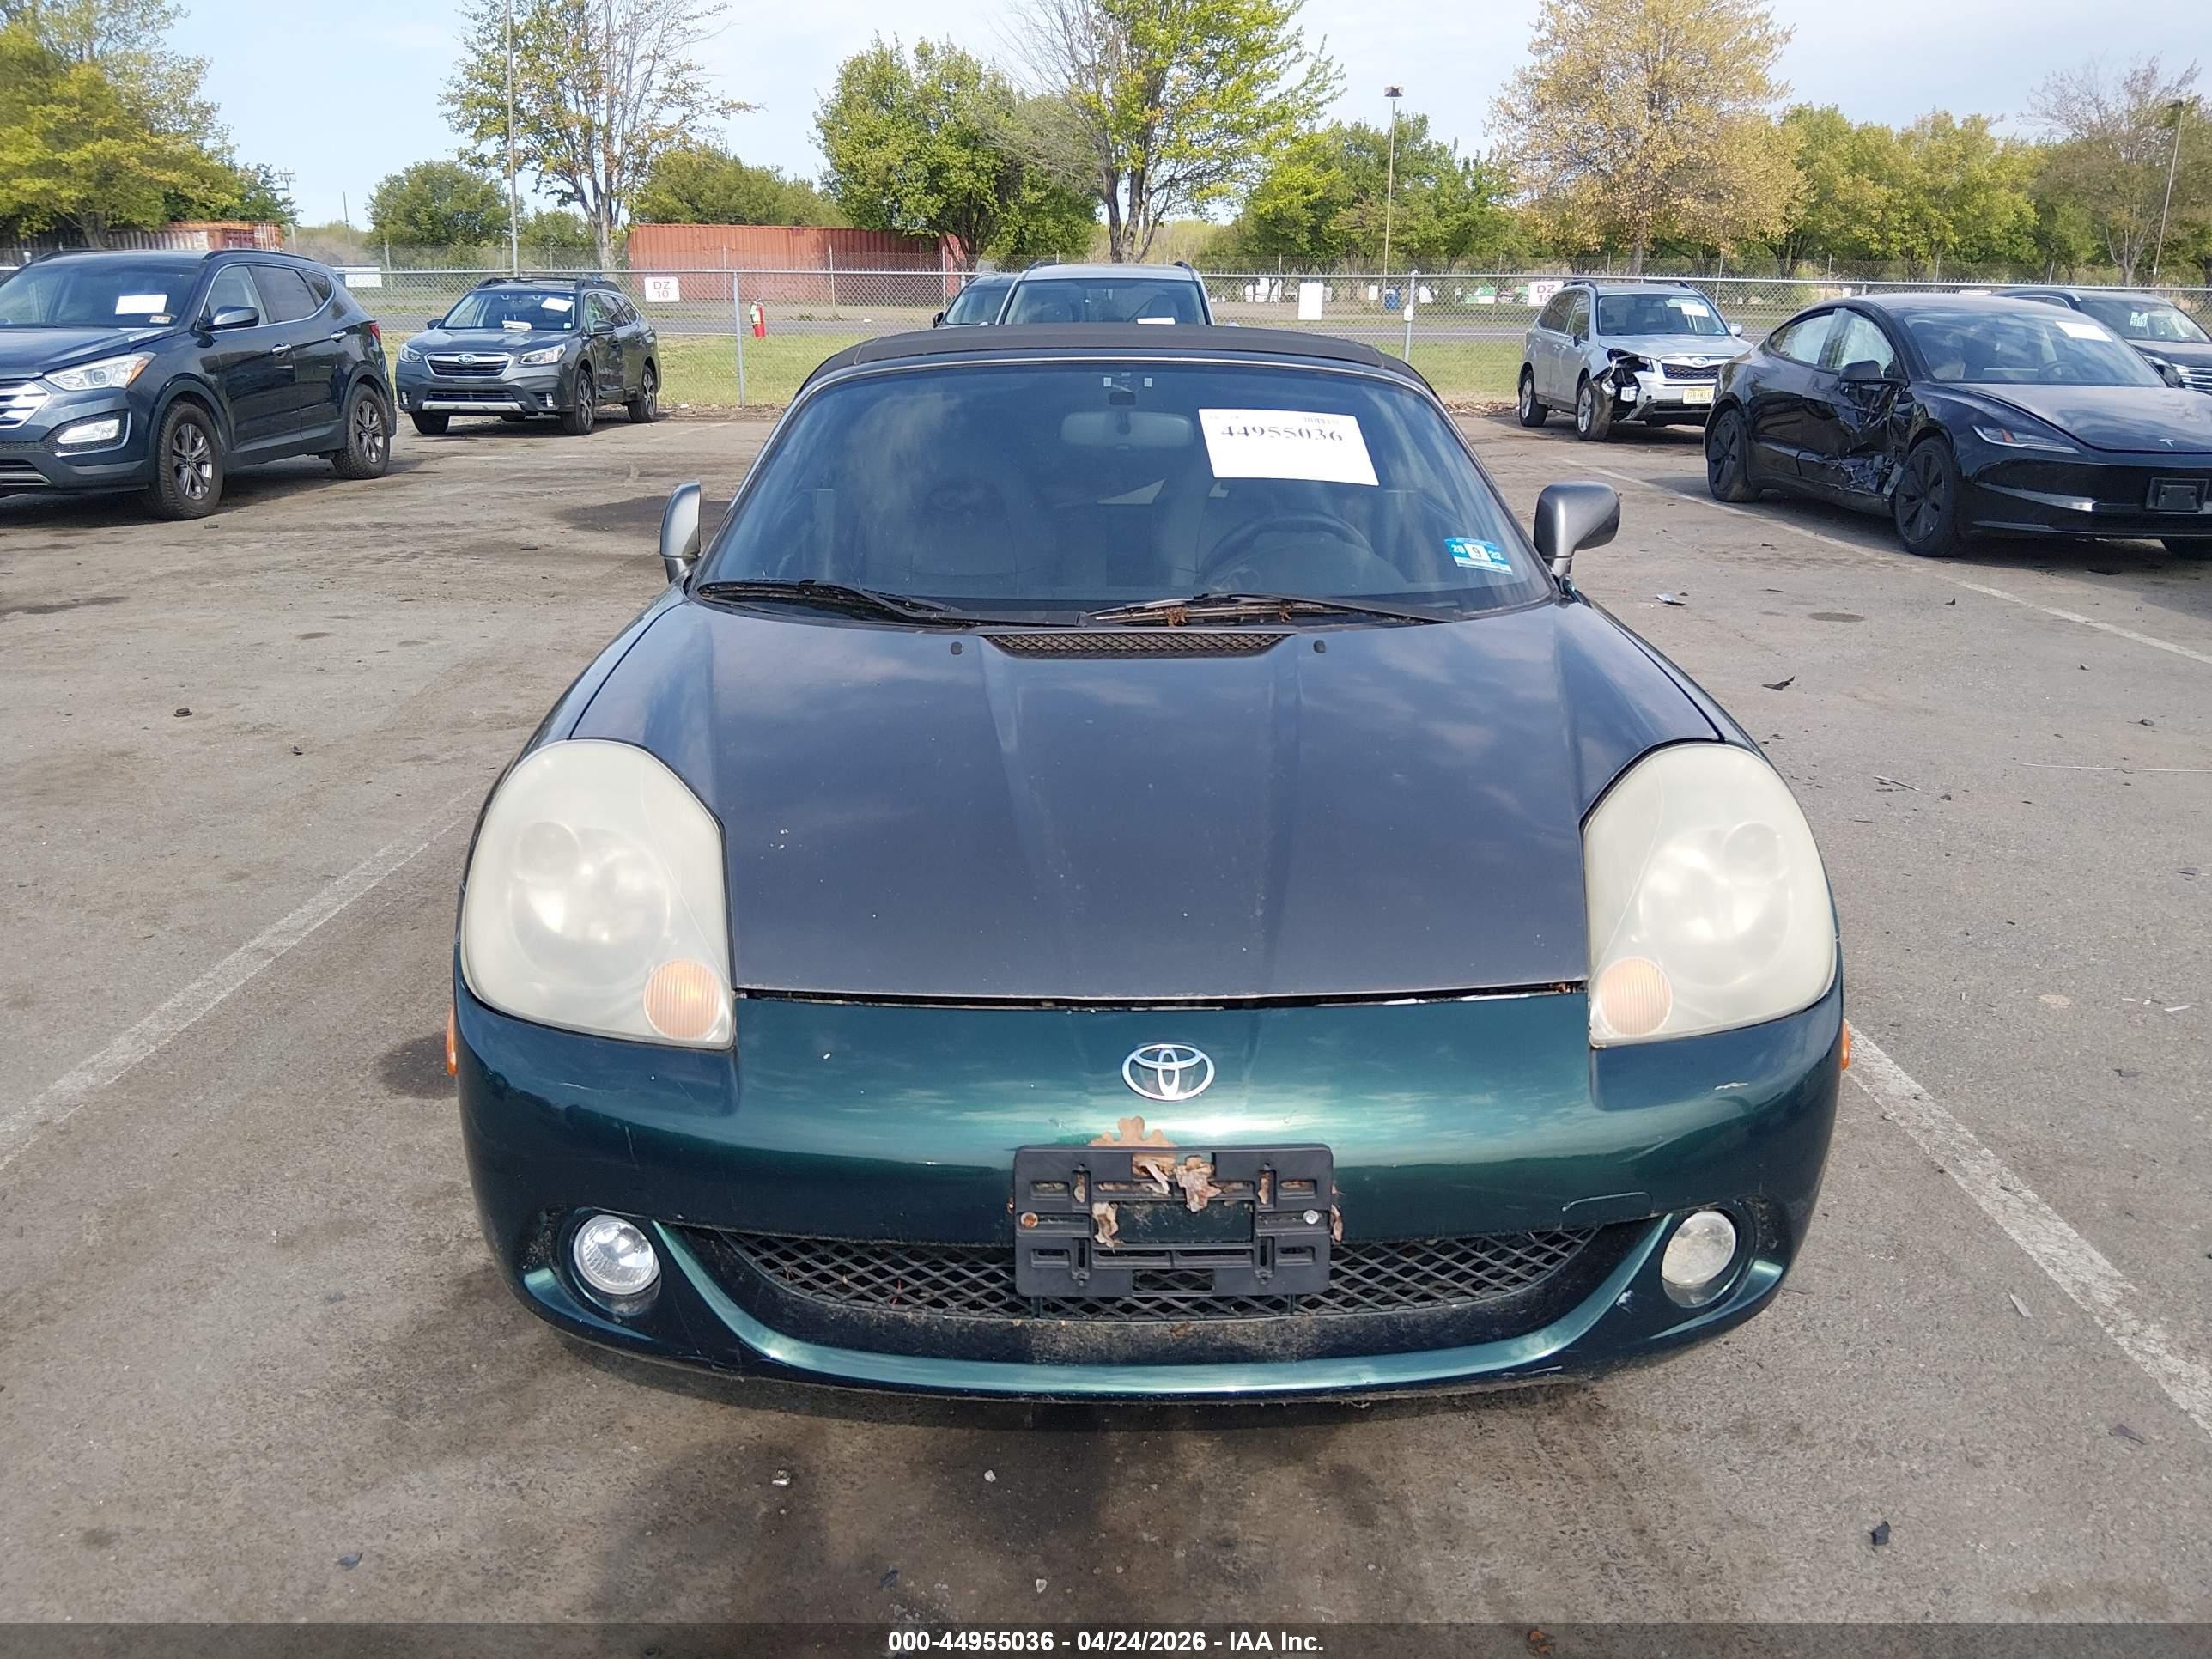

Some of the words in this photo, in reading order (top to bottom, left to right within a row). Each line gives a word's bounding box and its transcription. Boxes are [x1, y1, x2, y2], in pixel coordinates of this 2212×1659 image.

[653, 281, 671, 289] DZ
[1537, 285, 1555, 294] DZ
[1220, 425, 1344, 442] 44955036
[1471, 546, 1482, 558] 9
